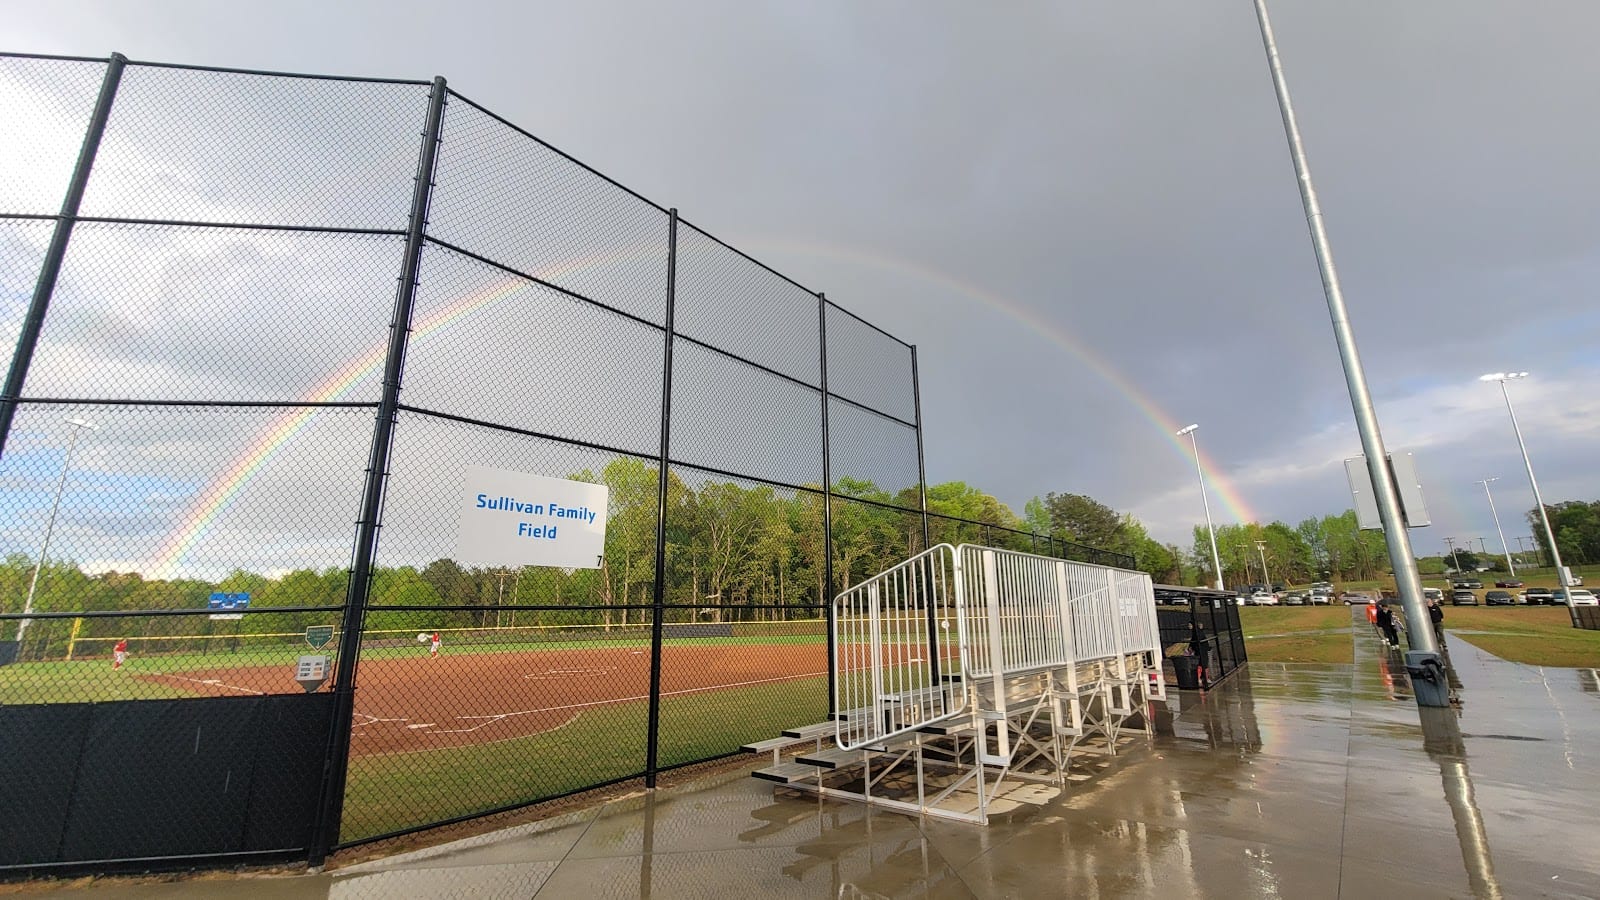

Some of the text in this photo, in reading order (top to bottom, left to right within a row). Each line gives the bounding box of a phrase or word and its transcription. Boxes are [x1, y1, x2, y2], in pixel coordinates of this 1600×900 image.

[477, 494, 596, 524] Sullivan Family
[518, 523, 557, 539] Field
[597, 555, 603, 567] 7
